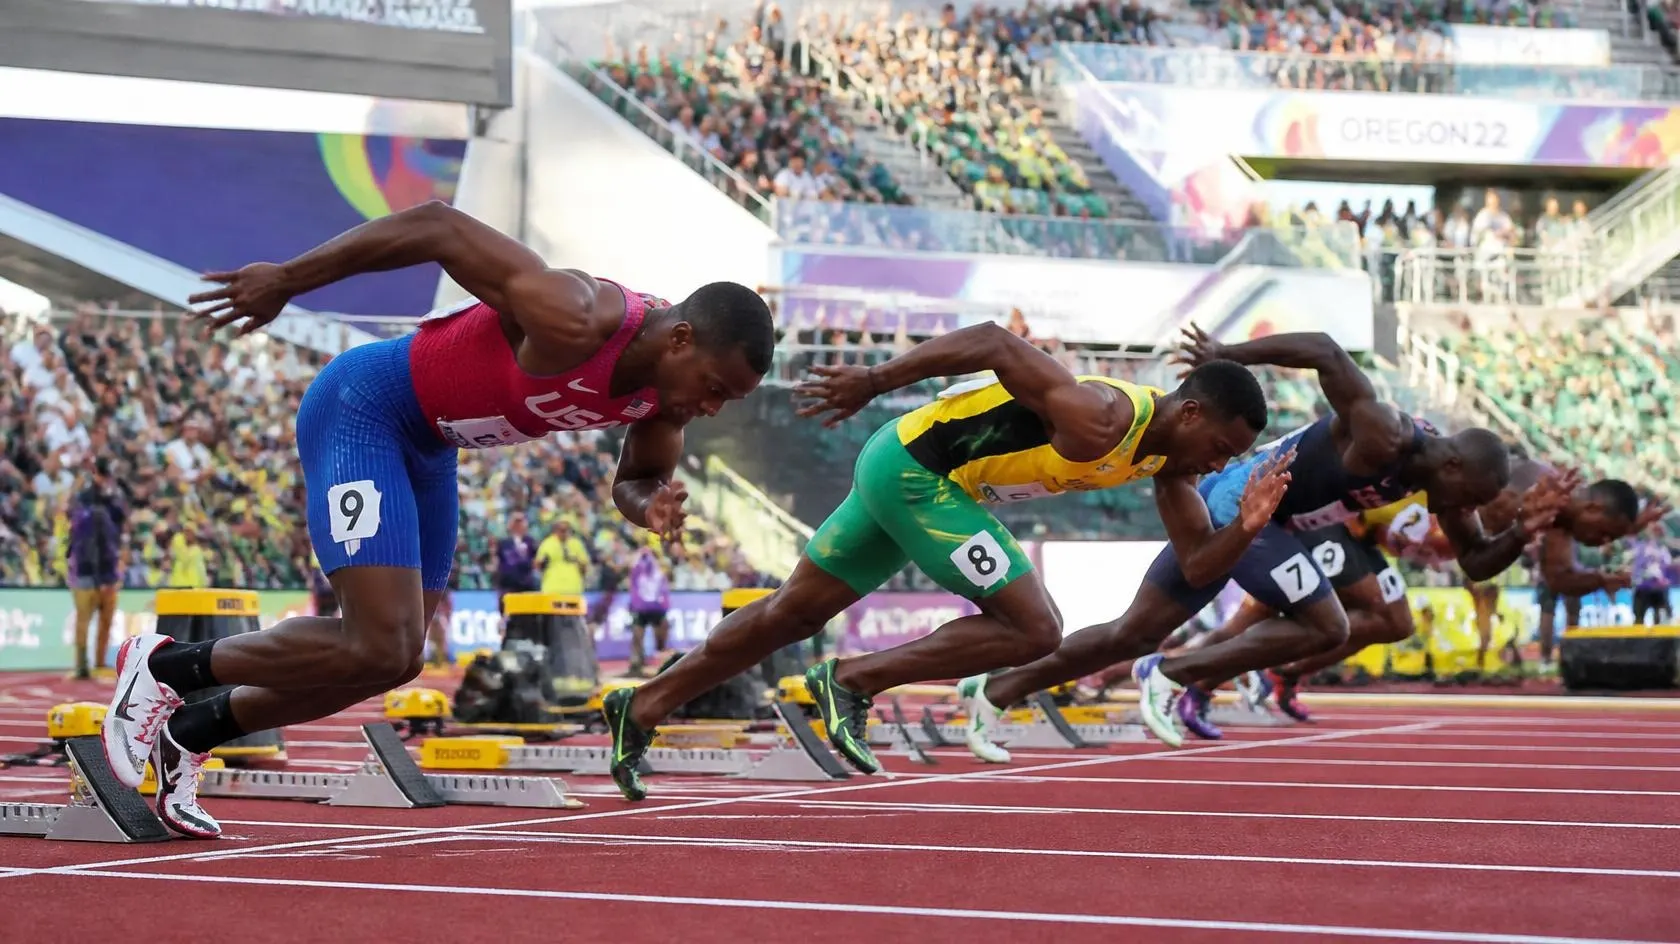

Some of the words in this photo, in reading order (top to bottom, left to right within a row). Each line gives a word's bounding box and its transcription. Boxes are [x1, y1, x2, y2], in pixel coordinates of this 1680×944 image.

[1340, 116, 1509, 148] OREGON22
[340, 489, 364, 531] 9
[967, 544, 997, 576] 8
[1285, 562, 1303, 591] 7
